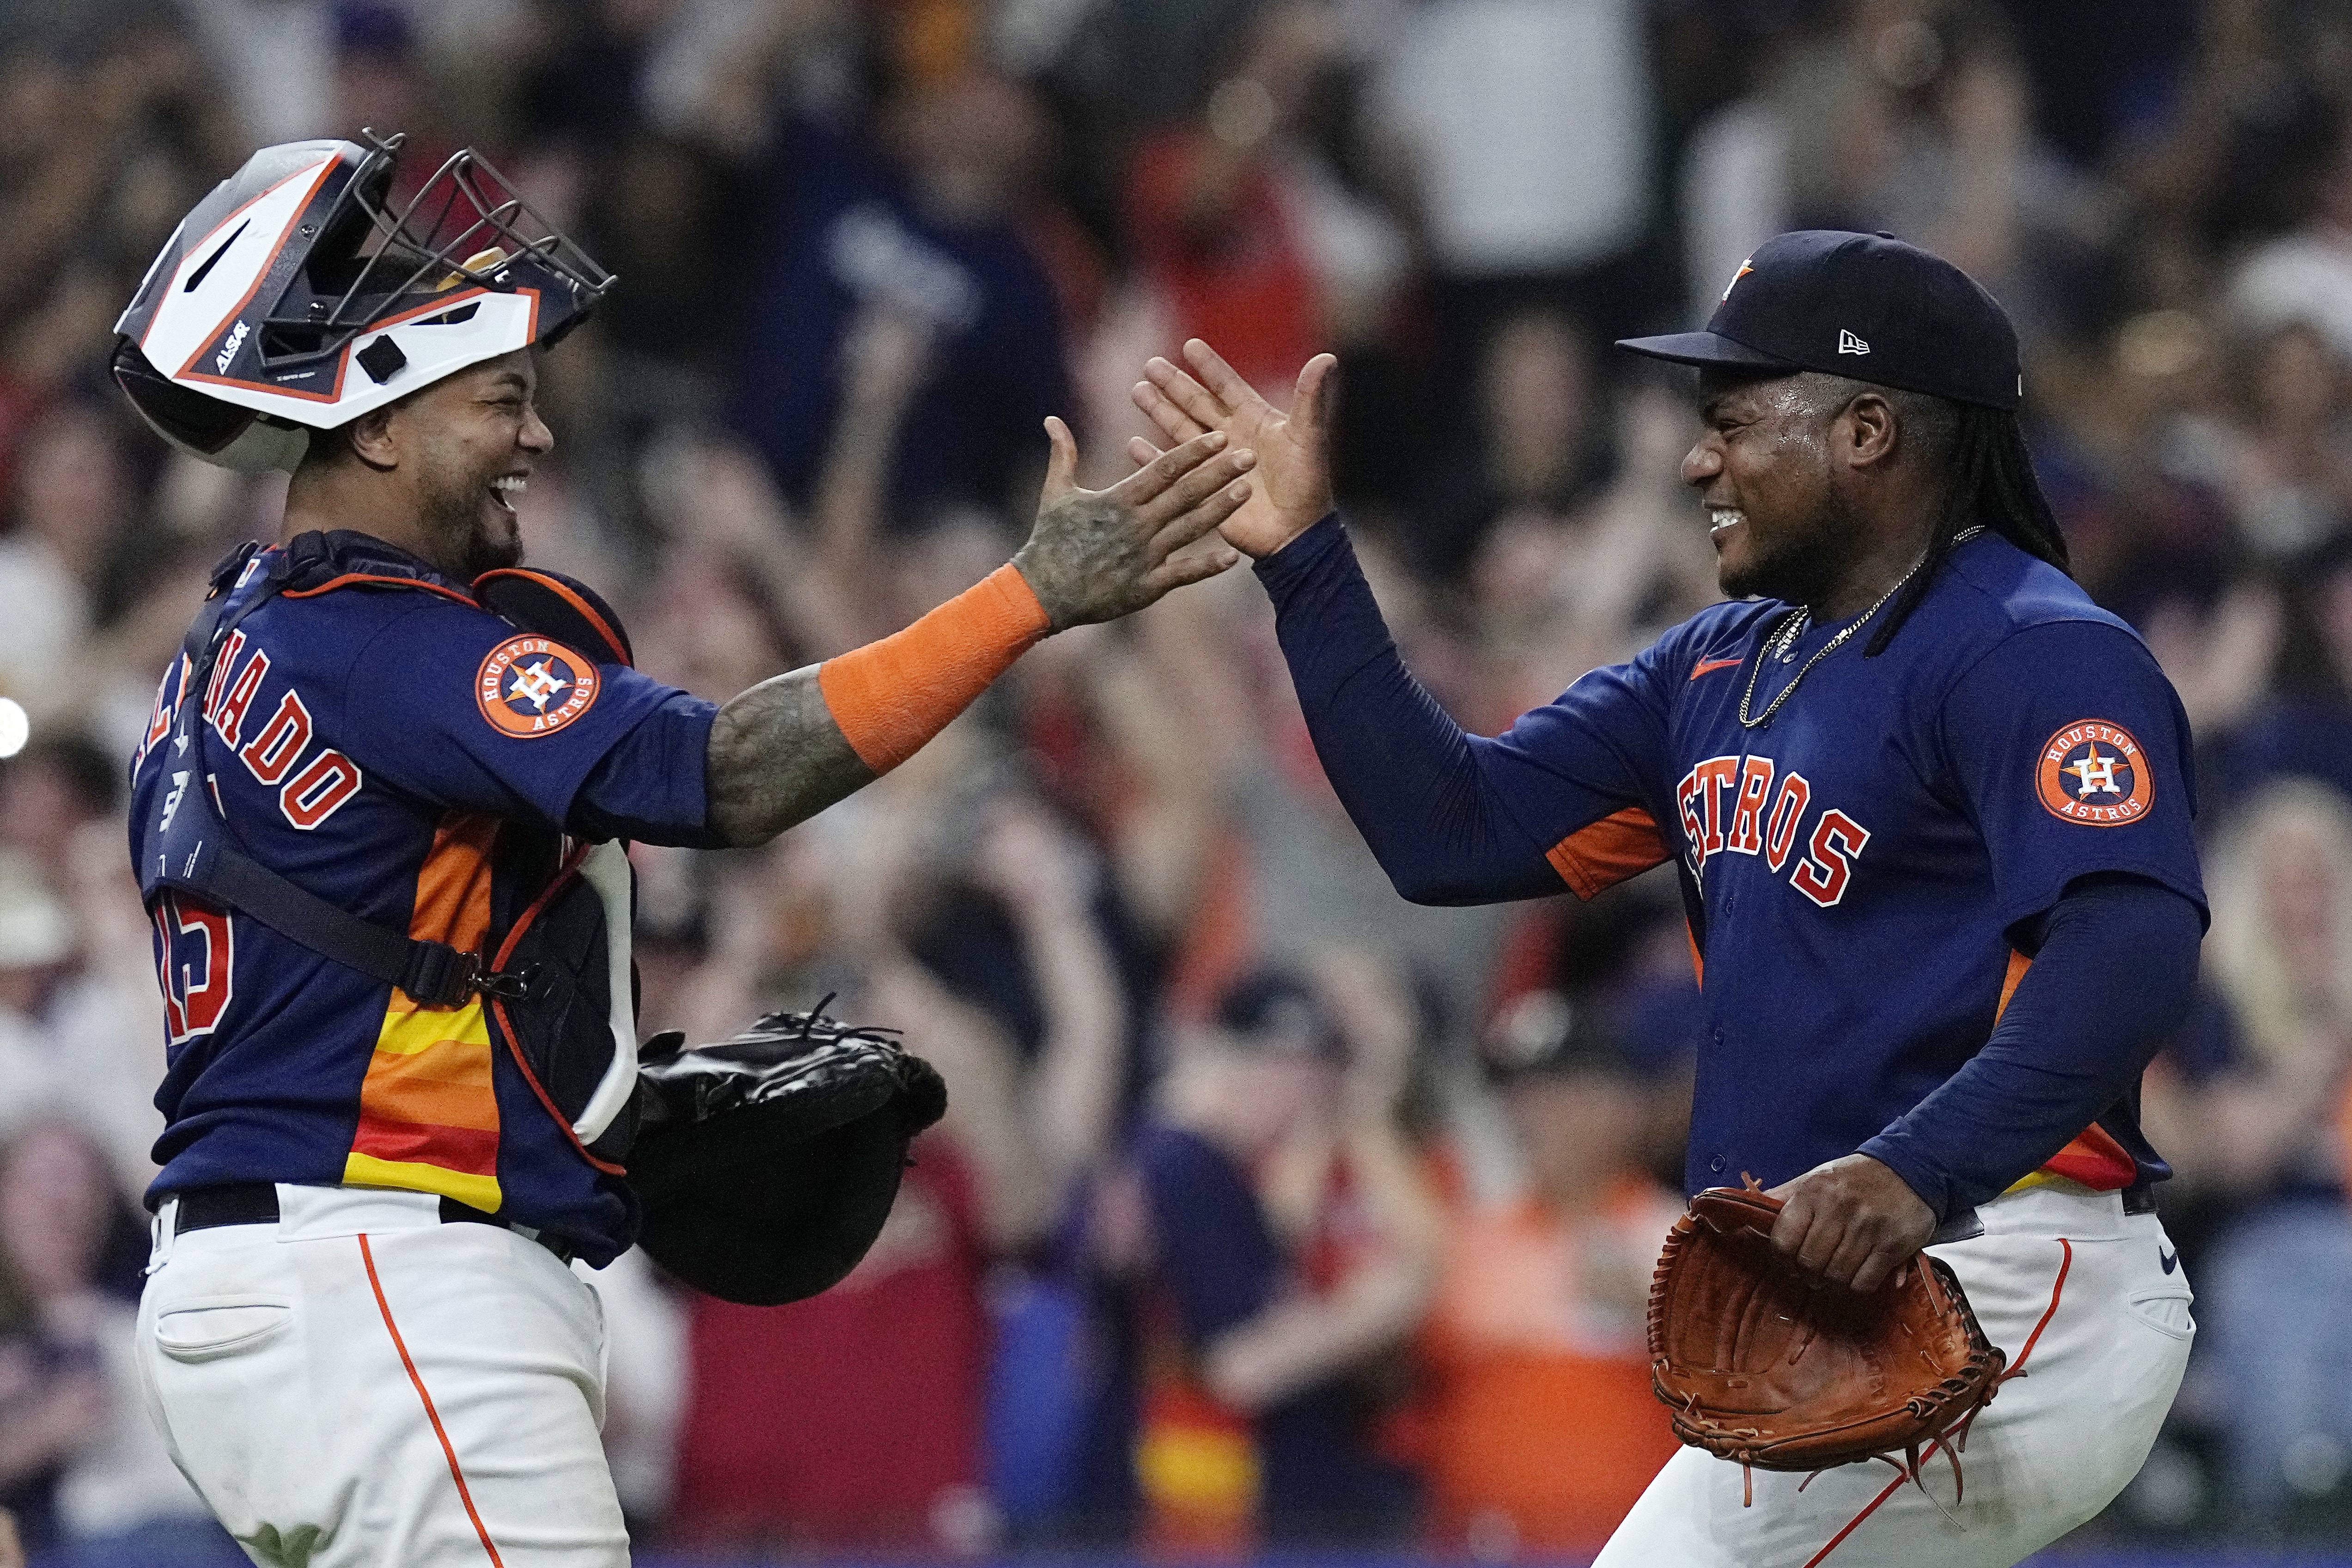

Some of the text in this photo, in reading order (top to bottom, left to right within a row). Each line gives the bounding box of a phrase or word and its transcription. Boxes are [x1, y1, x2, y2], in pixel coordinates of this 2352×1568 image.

[483, 641, 549, 702] HOUSTON
[509, 661, 566, 709] H
[532, 677, 593, 731] ASTROS
[2047, 726, 2137, 763] HOUSTON
[2073, 757, 2120, 794] H
[1677, 754, 1871, 907] STROS
[2061, 798, 2142, 820] ASTROS
